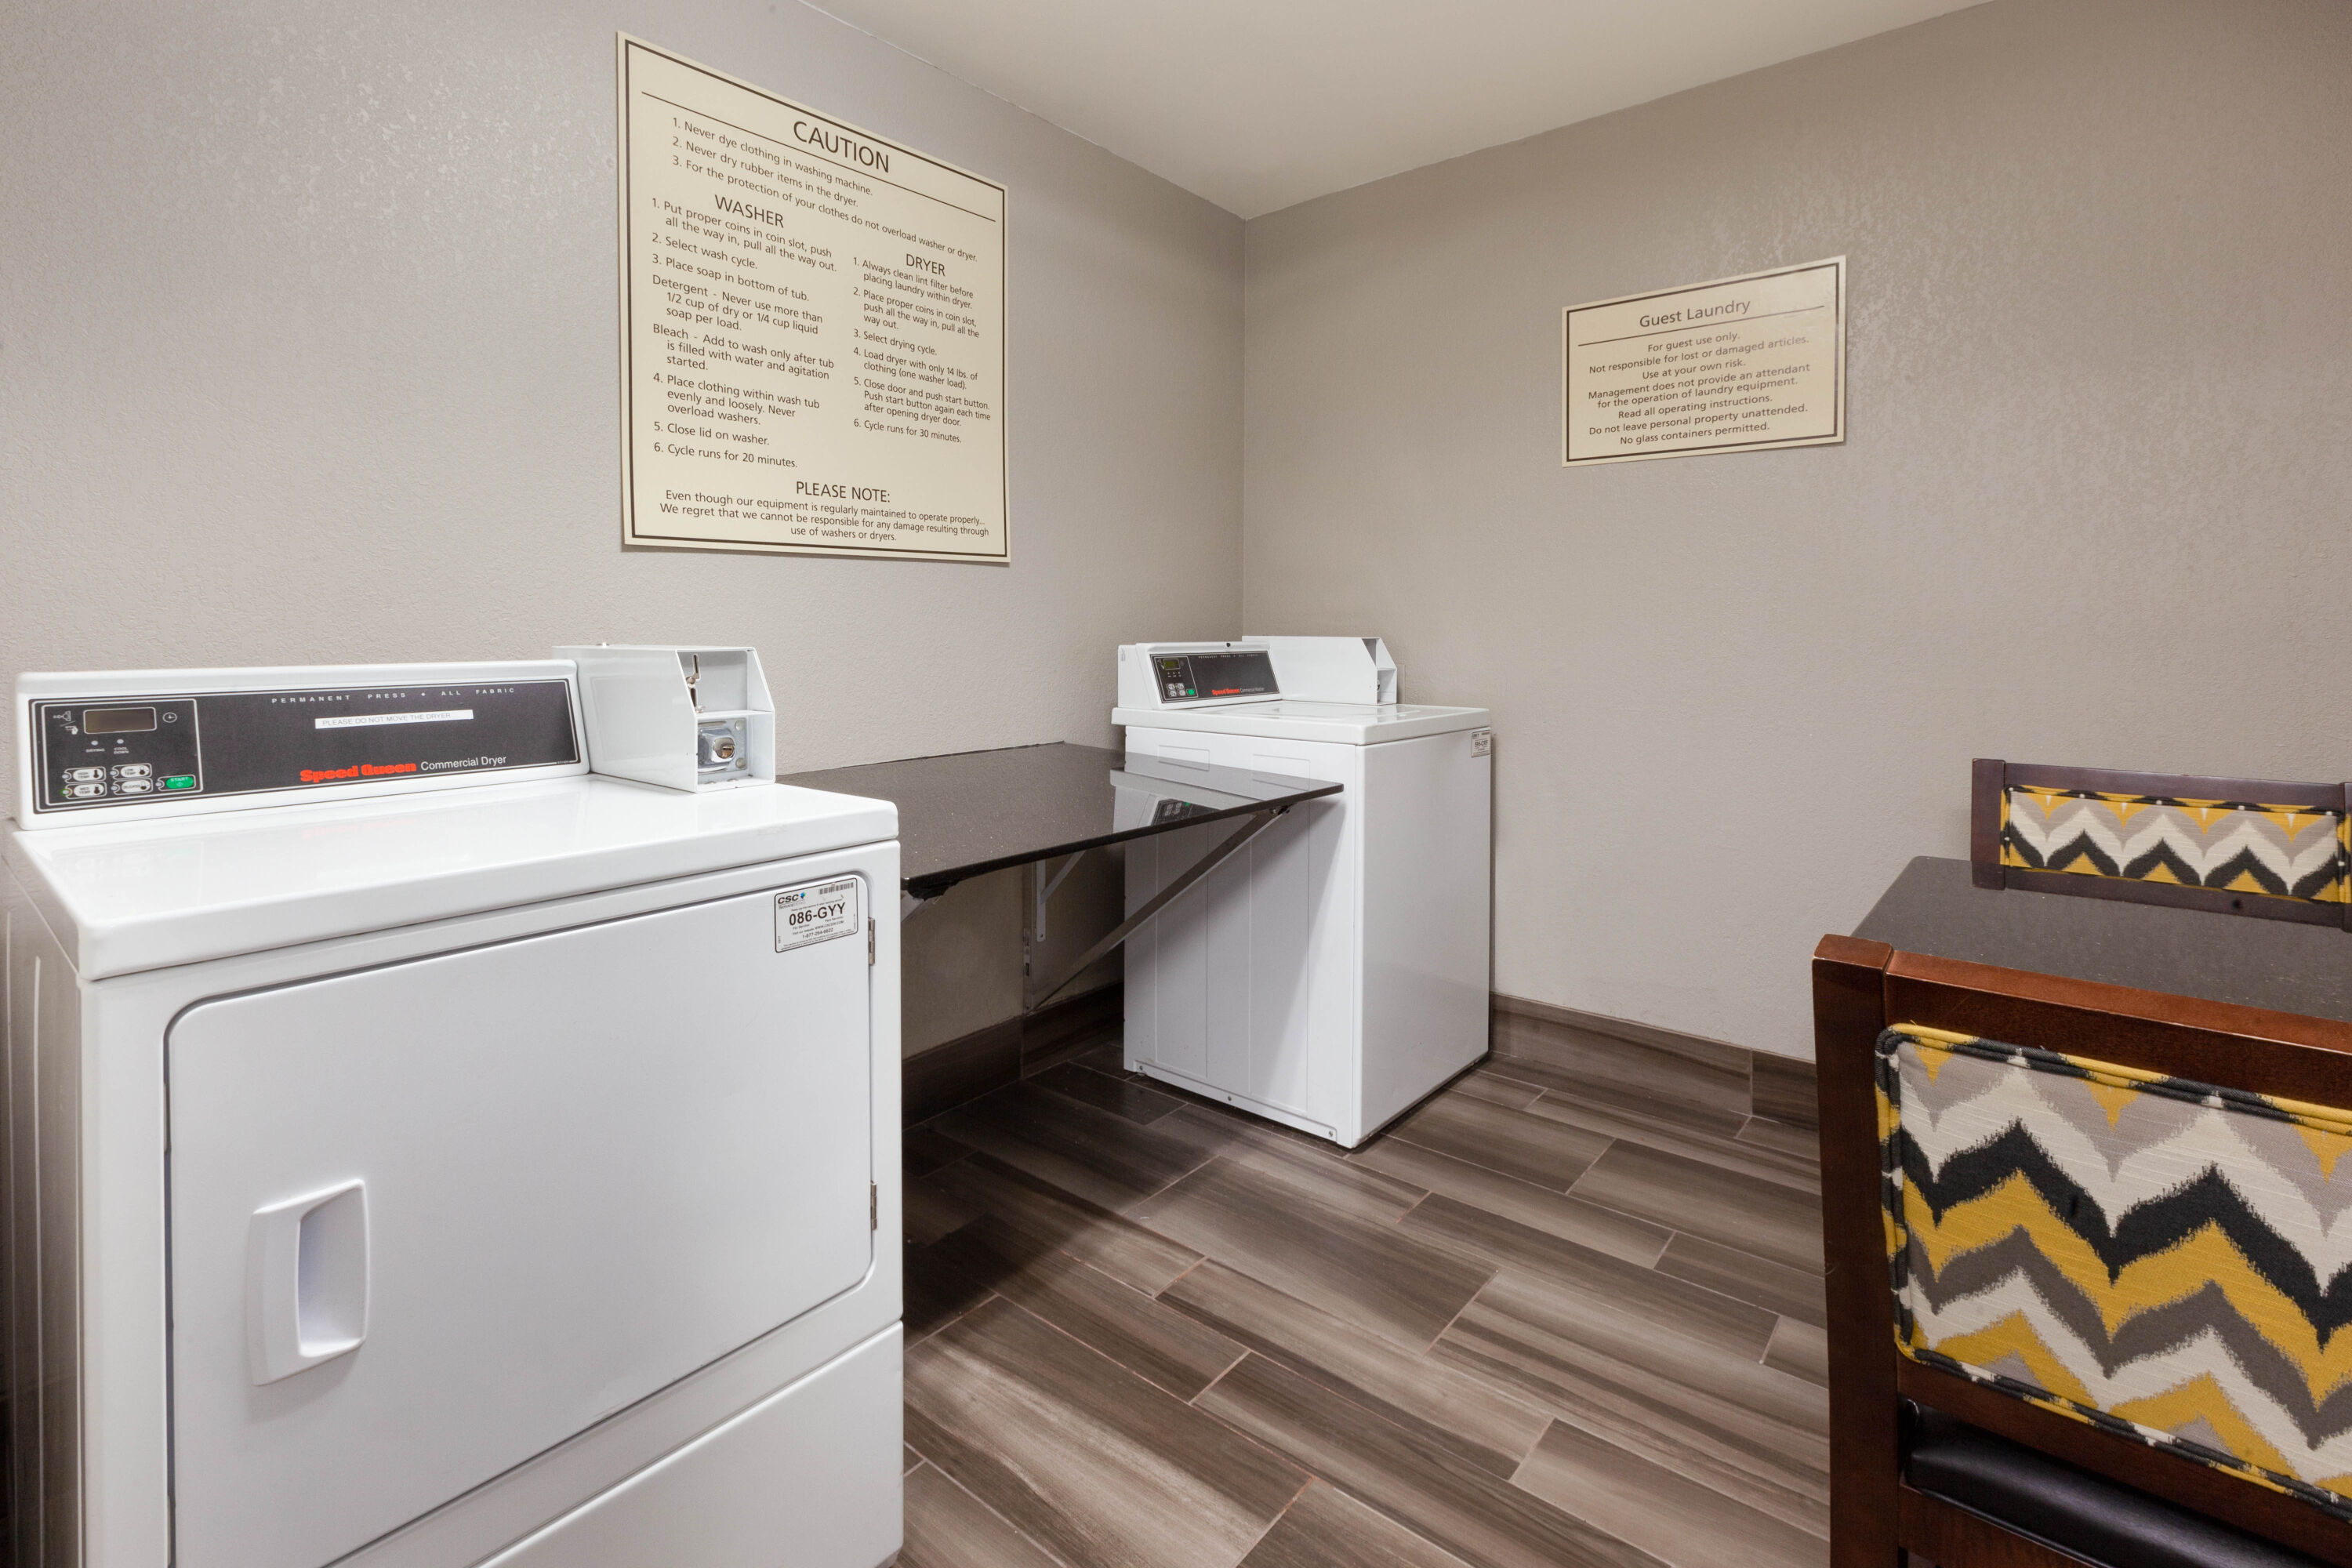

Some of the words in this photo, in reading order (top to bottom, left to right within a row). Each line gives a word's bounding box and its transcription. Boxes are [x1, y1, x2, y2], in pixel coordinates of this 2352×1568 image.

[673, 117, 681, 129] 1.
[684, 121, 716, 140] Never
[718, 134, 737, 148] dye
[740, 142, 780, 165] clothing
[783, 155, 792, 168] in
[794, 162, 833, 184] washing
[835, 176, 873, 196] machine.
[793, 121, 889, 173] CAUTION
[673, 136, 682, 148] 2.
[686, 140, 717, 159] Never
[720, 153, 738, 169] dry
[740, 162, 774, 178] rubber
[777, 171, 803, 188] items
[805, 181, 814, 192] in
[816, 186, 831, 198] the
[833, 192, 858, 208] dryer.
[672, 154, 682, 167] 3.
[686, 159, 703, 173] For
[706, 167, 724, 181] the
[728, 175, 779, 198] protection
[782, 192, 793, 202] of
[795, 197, 816, 210] your
[818, 204, 849, 221] clothes
[851, 214, 863, 225] do
[865, 220, 880, 231] not
[881, 226, 916, 242] overload
[918, 238, 946, 251] washer
[947, 246, 956, 255] or
[956, 249, 978, 262] dryer.
[714, 194, 784, 229] WASHER
[652, 198, 660, 209] 1.
[664, 200, 682, 215] Put
[686, 209, 721, 226] proper
[724, 221, 750, 235] coins
[753, 227, 763, 238] in
[765, 233, 786, 245] coin
[788, 238, 807, 252] slot,
[811, 245, 832, 258] push
[665, 216, 678, 227] all
[682, 220, 699, 234] the
[703, 228, 724, 242] way
[728, 232, 740, 246] in,
[743, 239, 762, 251] pull
[765, 245, 776, 255] all
[779, 248, 795, 260] the
[797, 255, 816, 268] way
[818, 261, 837, 272] out.
[853, 256, 859, 267] 1.
[862, 260, 891, 276] Always
[893, 269, 913, 281] clean
[916, 274, 928, 286] lint
[930, 278, 948, 291] filter
[949, 284, 974, 299] before
[906, 253, 946, 277] DRYER
[863, 273, 893, 289] placing
[895, 280, 924, 298] laundry
[927, 291, 950, 303] within
[952, 297, 972, 310] dryer.
[1639, 310, 1682, 328] Guest
[1687, 299, 1751, 321] Laundry
[1589, 365, 1606, 374] Not
[1608, 357, 1661, 372] responsible
[1664, 354, 1679, 363] for
[1681, 351, 1699, 361] lost
[1701, 350, 1713, 358] or
[1715, 340, 1765, 356] damaged
[1767, 336, 1809, 349] articles.
[1648, 343, 1663, 353] For
[1666, 339, 1693, 352] guest
[1696, 336, 1712, 345] use
[1715, 332, 1740, 343] only.
[1588, 385, 1650, 400] Management
[1653, 383, 1675, 391] does
[1678, 379, 1694, 388] not
[1697, 373, 1737, 387] provide
[1755, 363, 1811, 378] attendant
[1642, 371, 1659, 379] Use
[1662, 368, 1672, 377] at
[1675, 366, 1697, 377] your
[1700, 363, 1722, 372] own
[1725, 358, 1746, 368] risk.
[1597, 400, 1611, 408] for
[1613, 398, 1628, 407] the
[1632, 393, 1679, 405] operation
[1681, 389, 1692, 398] of
[1695, 385, 1733, 397] laundry
[1737, 377, 1798, 392] equipment.
[1618, 408, 1641, 419] Read
[1644, 407, 1655, 416] all
[1658, 402, 1707, 416] operating
[1710, 395, 1773, 408] instructions.
[1589, 426, 1602, 435] Do
[1604, 425, 1621, 434] not
[1623, 423, 1647, 431] leave
[1650, 416, 1691, 430] personal
[1694, 412, 1739, 426] property
[1741, 403, 1808, 419] unattended.
[1635, 434, 1659, 445] glass
[1661, 430, 1712, 441] containers
[1715, 421, 1770, 437] permitted.
[654, 441, 664, 453] 6.
[667, 444, 695, 457] Cycle
[699, 449, 721, 459] runs
[724, 449, 739, 461] for
[742, 452, 755, 463] 20
[757, 455, 798, 468] minutes.
[666, 489, 691, 501] Even
[695, 492, 733, 506] though
[757, 499, 808, 511] equipment
[811, 502, 818, 512] is
[820, 505, 858, 517] regularly
[861, 509, 906, 518] maintained
[908, 511, 916, 520] to
[919, 514, 948, 522] operate
[796, 481, 847, 499] PLEASE
[851, 486, 891, 503] NOTE:
[271, 695, 351, 703] PERMANENT
[300, 765, 358, 782] Speed
[361, 763, 417, 776] Queen
[420, 758, 479, 771] Commercial
[481, 756, 507, 768] Dryer
[778, 894, 799, 904] CSC
[789, 902, 846, 926] 086-GYY
